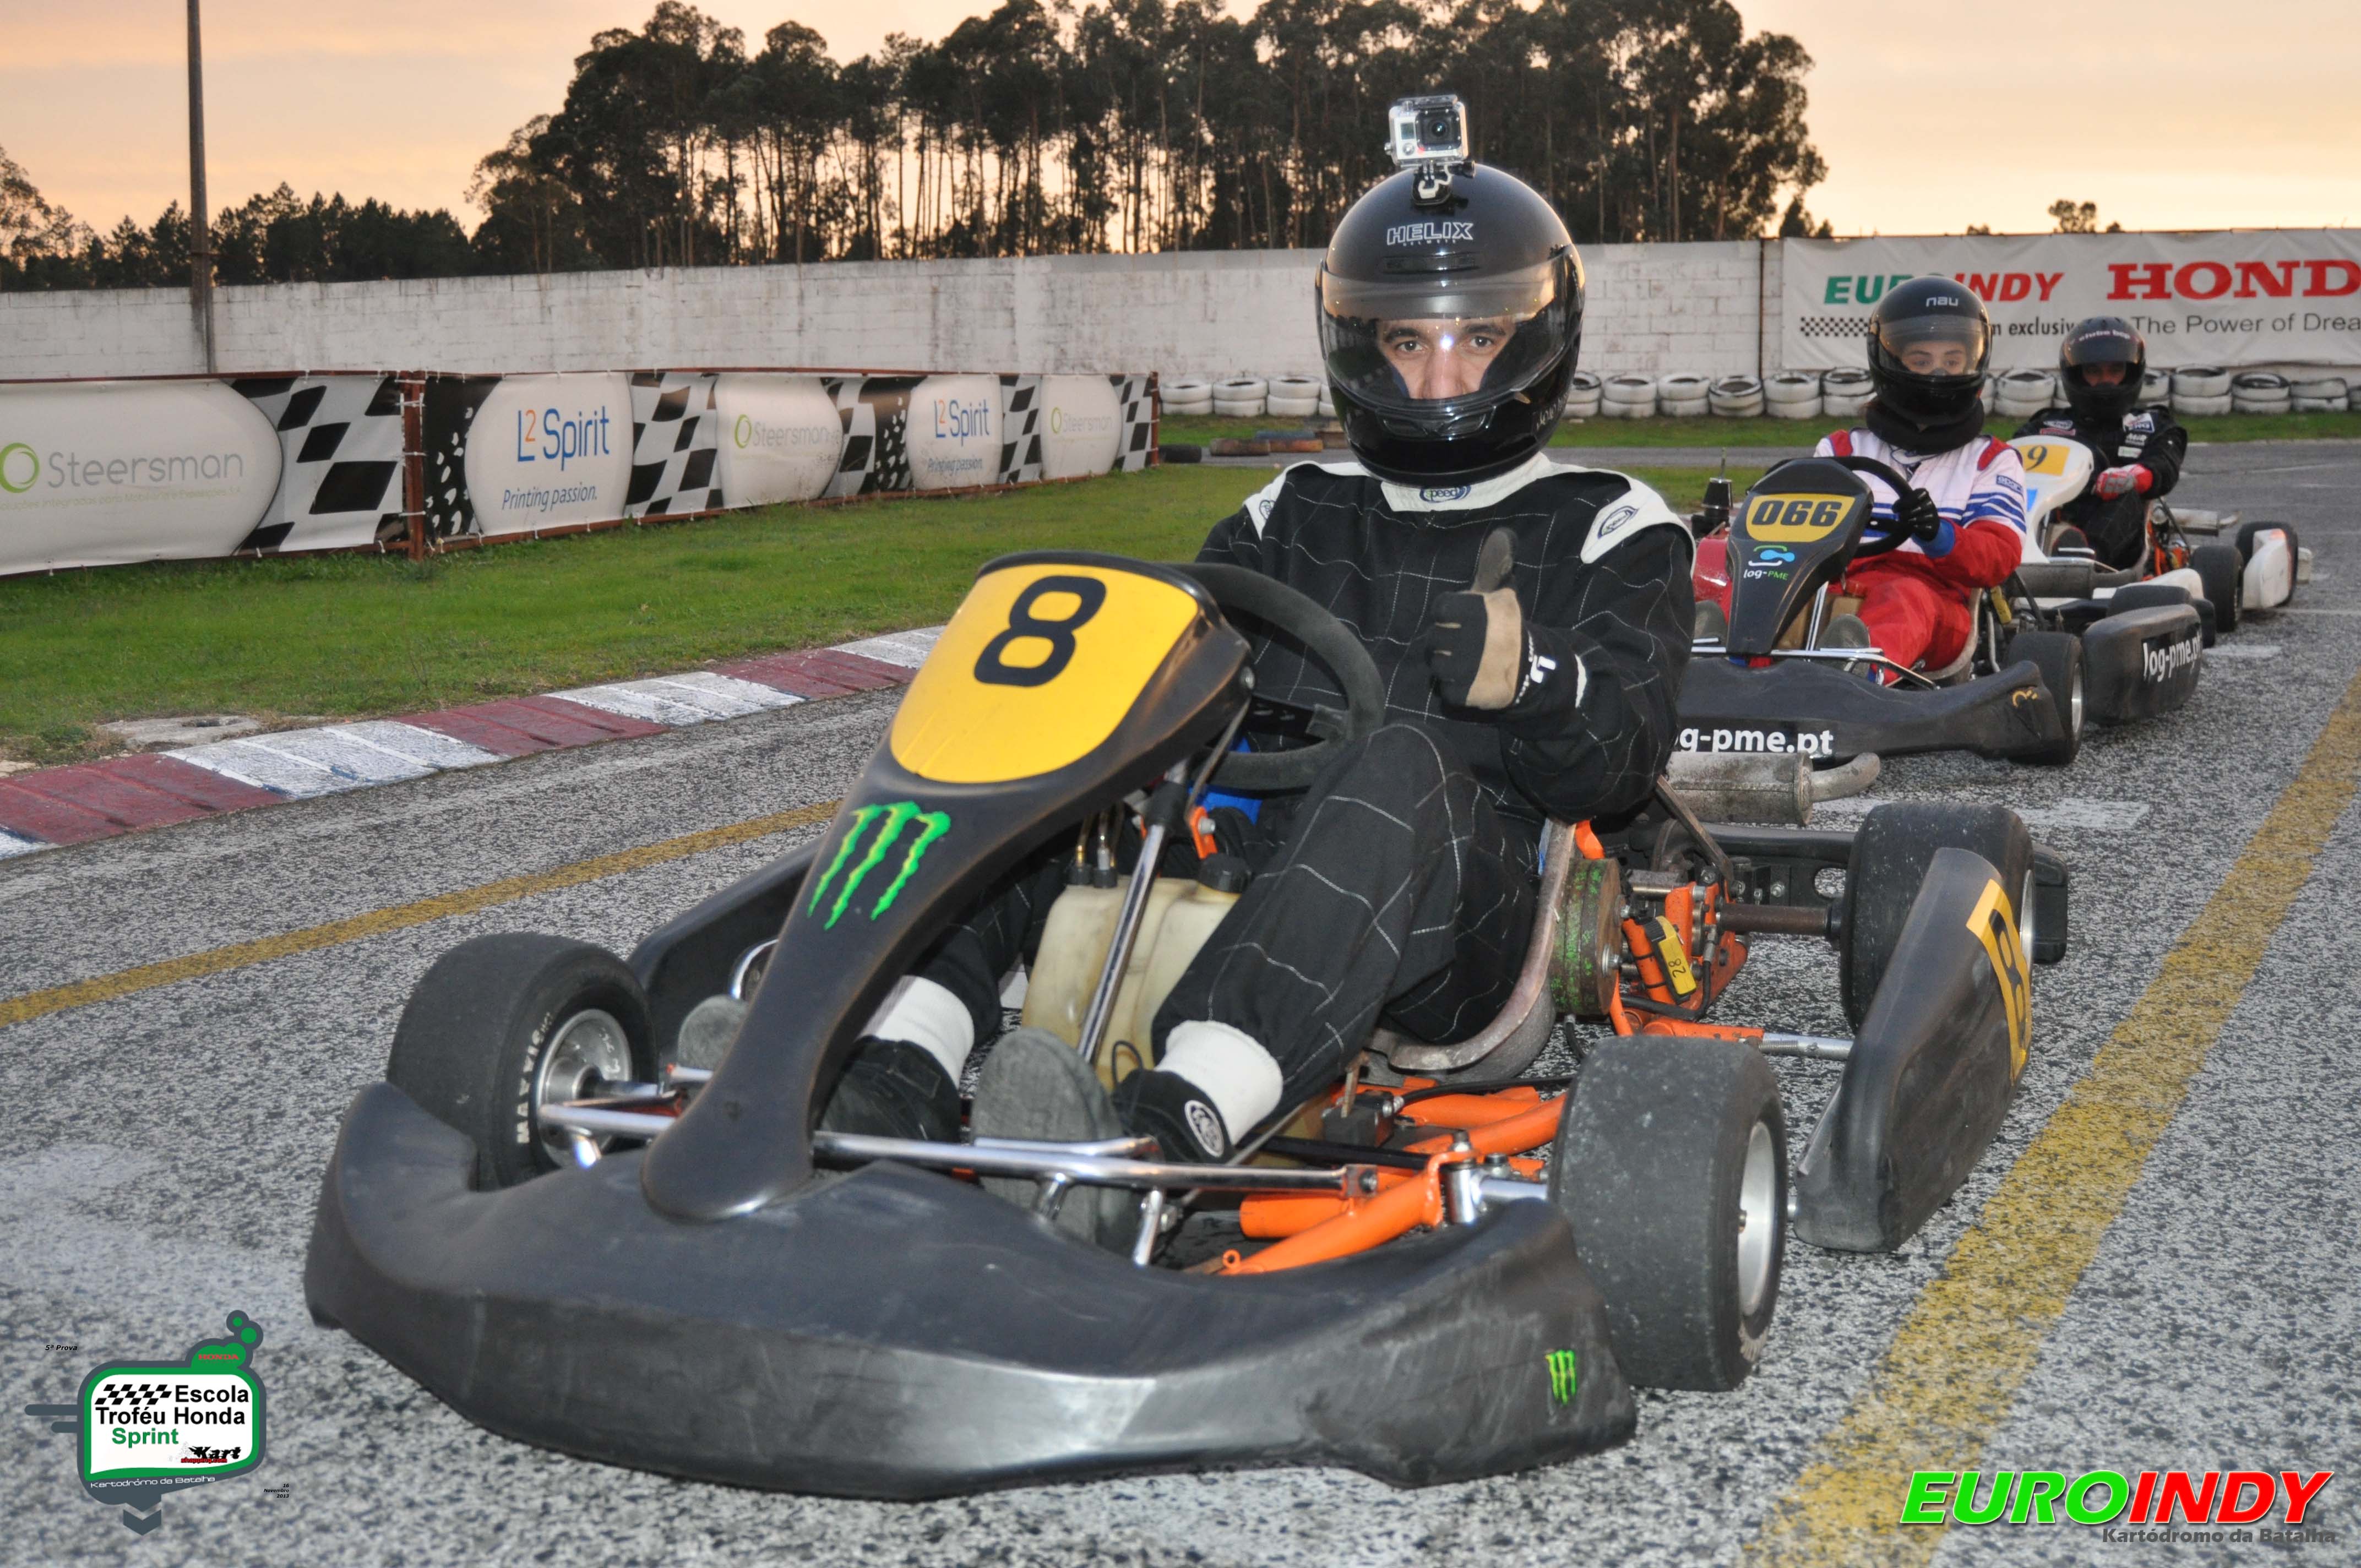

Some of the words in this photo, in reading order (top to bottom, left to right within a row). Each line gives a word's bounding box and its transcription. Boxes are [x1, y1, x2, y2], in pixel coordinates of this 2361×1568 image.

[1387, 222, 1474, 246] HELIX
[1926, 296, 1959, 307] nau
[2131, 315, 2175, 334] The
[2186, 314, 2260, 334] Power
[2272, 313, 2295, 331] of
[753, 421, 828, 447] Steersman
[48, 450, 243, 488] Steersman
[2026, 445, 2048, 470] 9
[502, 487, 550, 513] Printing
[550, 481, 597, 511] passion.
[1751, 499, 1843, 527] 066
[1743, 569, 1789, 580] log-PME
[974, 575, 1106, 687] 8
[1676, 727, 1834, 755] g-pme.pt
[1988, 908, 2027, 1047] 8
